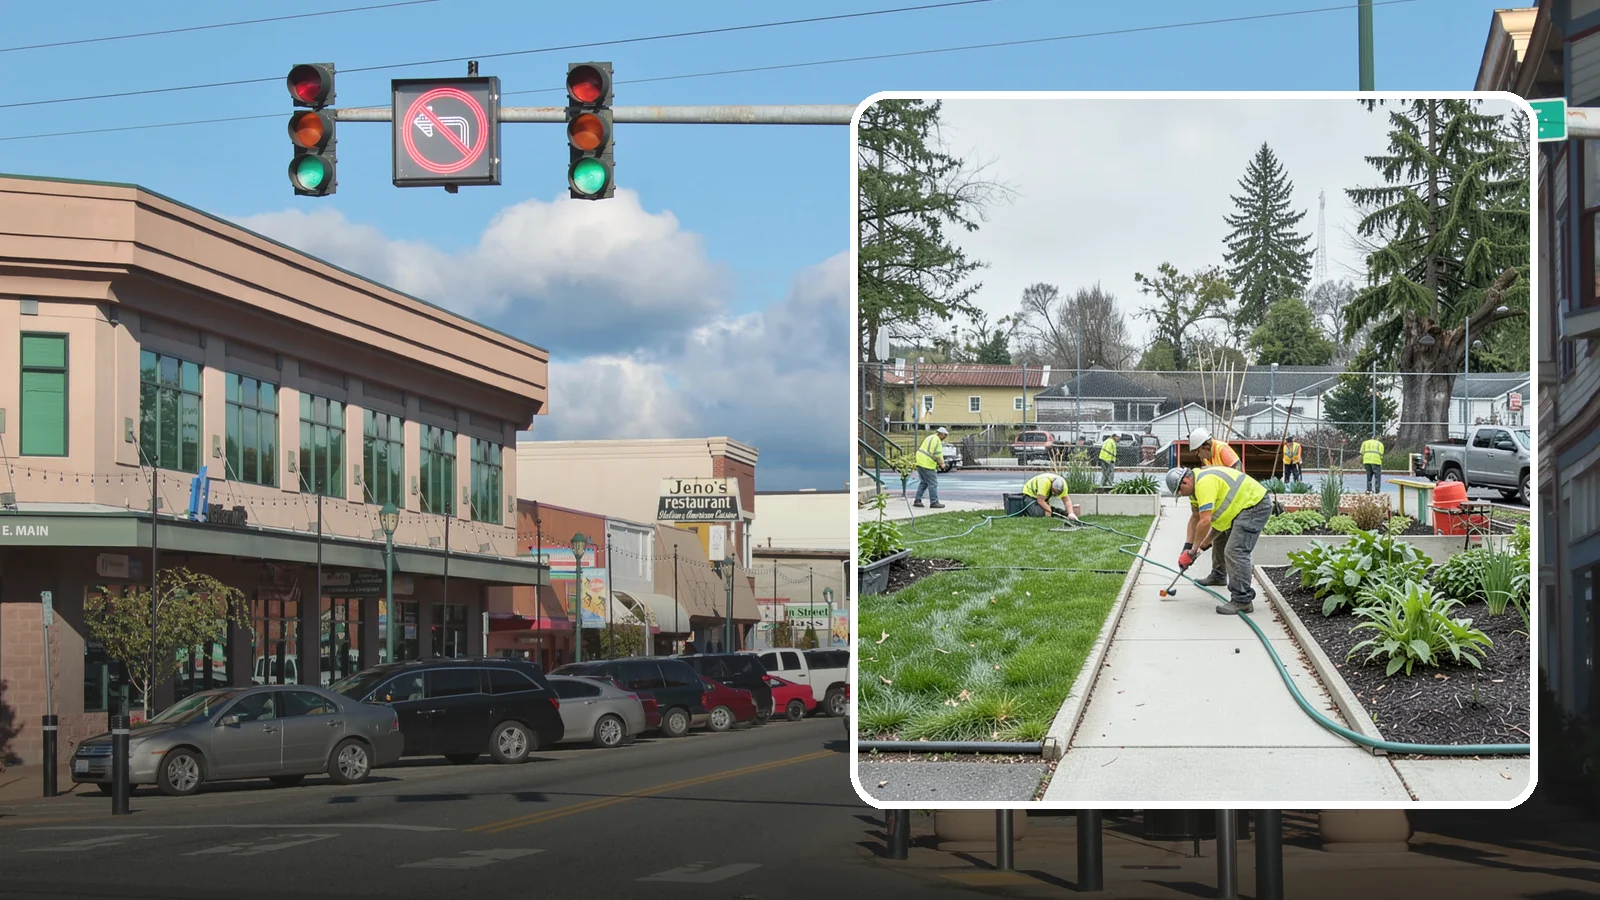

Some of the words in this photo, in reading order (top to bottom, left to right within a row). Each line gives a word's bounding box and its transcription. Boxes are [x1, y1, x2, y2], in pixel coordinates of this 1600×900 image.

[670, 480, 727, 494] Jeno's
[665, 496, 731, 509] restaurant
[686, 510, 714, 519] American
[715, 510, 737, 519] Cuisine
[2, 525, 13, 536] E.
[15, 525, 49, 536] MAIN
[797, 607, 828, 617] Street
